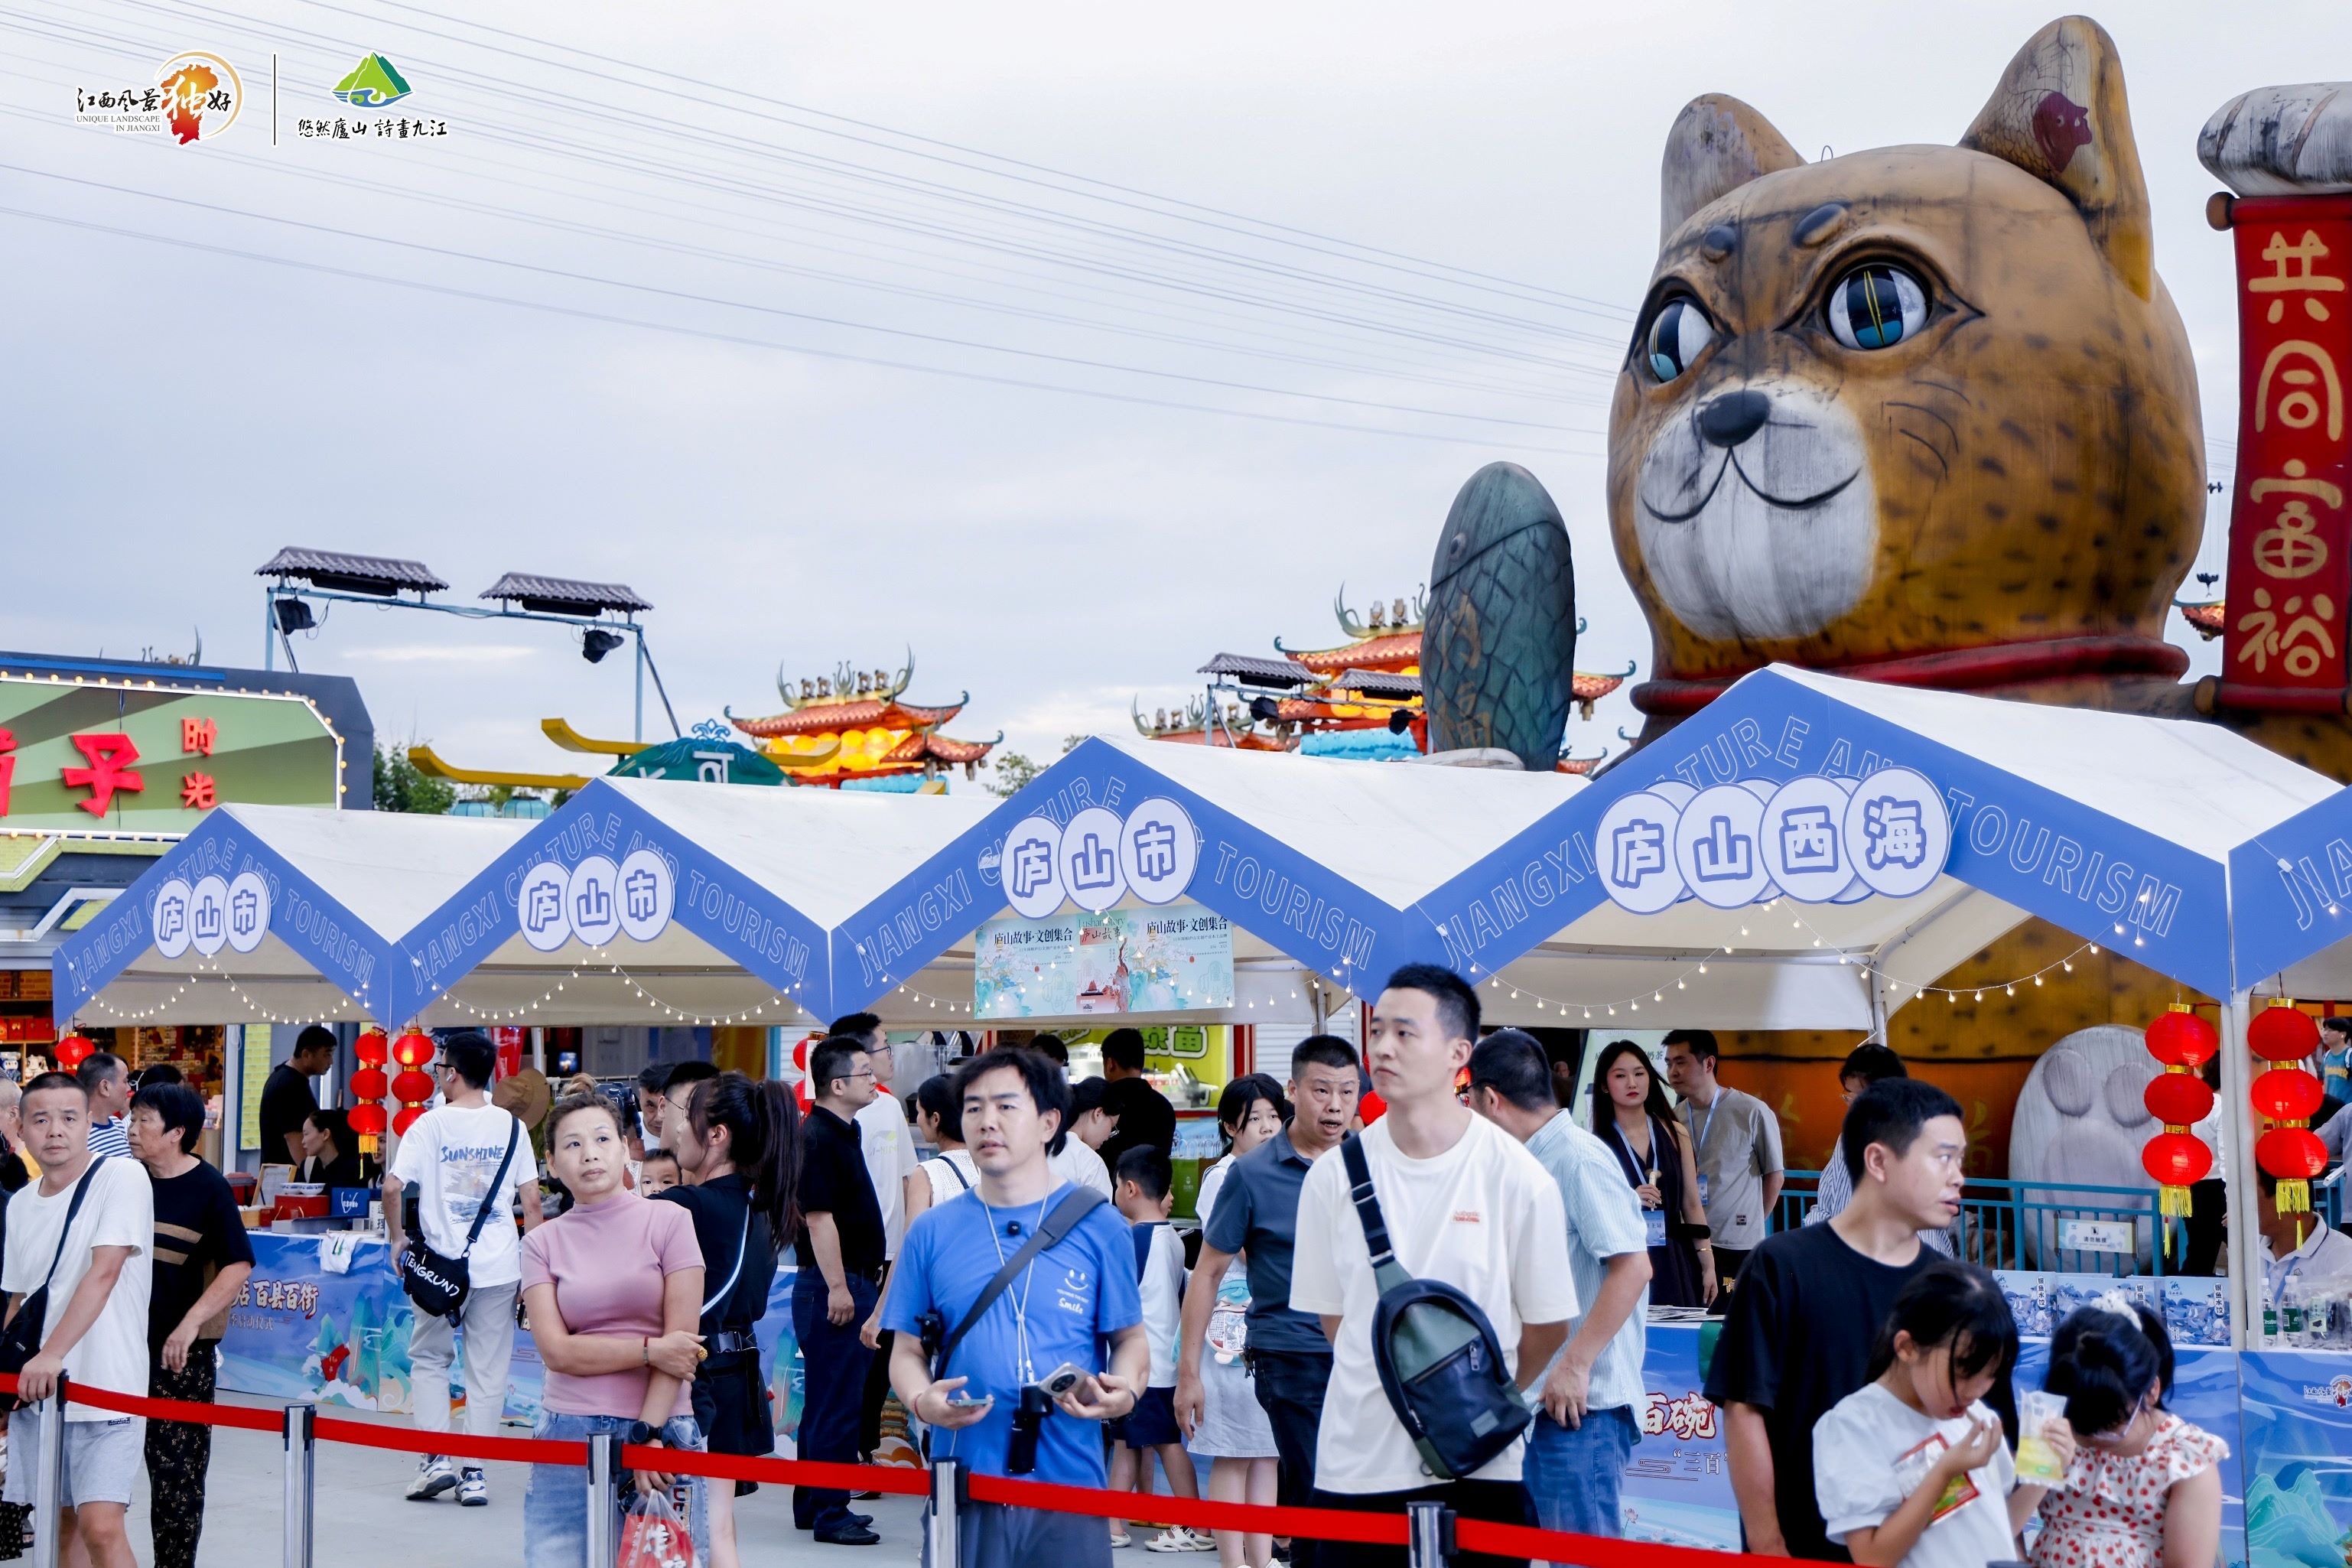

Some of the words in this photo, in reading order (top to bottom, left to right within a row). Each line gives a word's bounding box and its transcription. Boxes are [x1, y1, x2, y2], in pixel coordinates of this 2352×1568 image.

[2238, 229, 2346, 678] 共同富裕
[0, 728, 145, 818] 子
[181, 717, 219, 810] 时光
[1012, 820, 1176, 898] 庐山市
[1441, 829, 1598, 970] JIANGXI
[1947, 786, 2182, 938] TOURISM
[1611, 795, 1926, 890] 庐山西海
[159, 889, 257, 942] 庐山市
[411, 892, 500, 995] JIANGXI
[689, 870, 810, 982] TOURISM
[527, 868, 657, 933] 庐山市
[858, 868, 974, 987] JIANGXI
[1215, 841, 1375, 971] TOURISM
[1147, 916, 1228, 935] 庐山故事·文创集合
[73, 907, 143, 997] JIANGXI
[285, 890, 376, 984] TOURISM
[441, 1145, 505, 1163] SUNSHINE
[252, 1279, 319, 1319] 百县百街
[1058, 1297, 1083, 1314] Smile
[2215, 1284, 2224, 1314] 银鱼水饺
